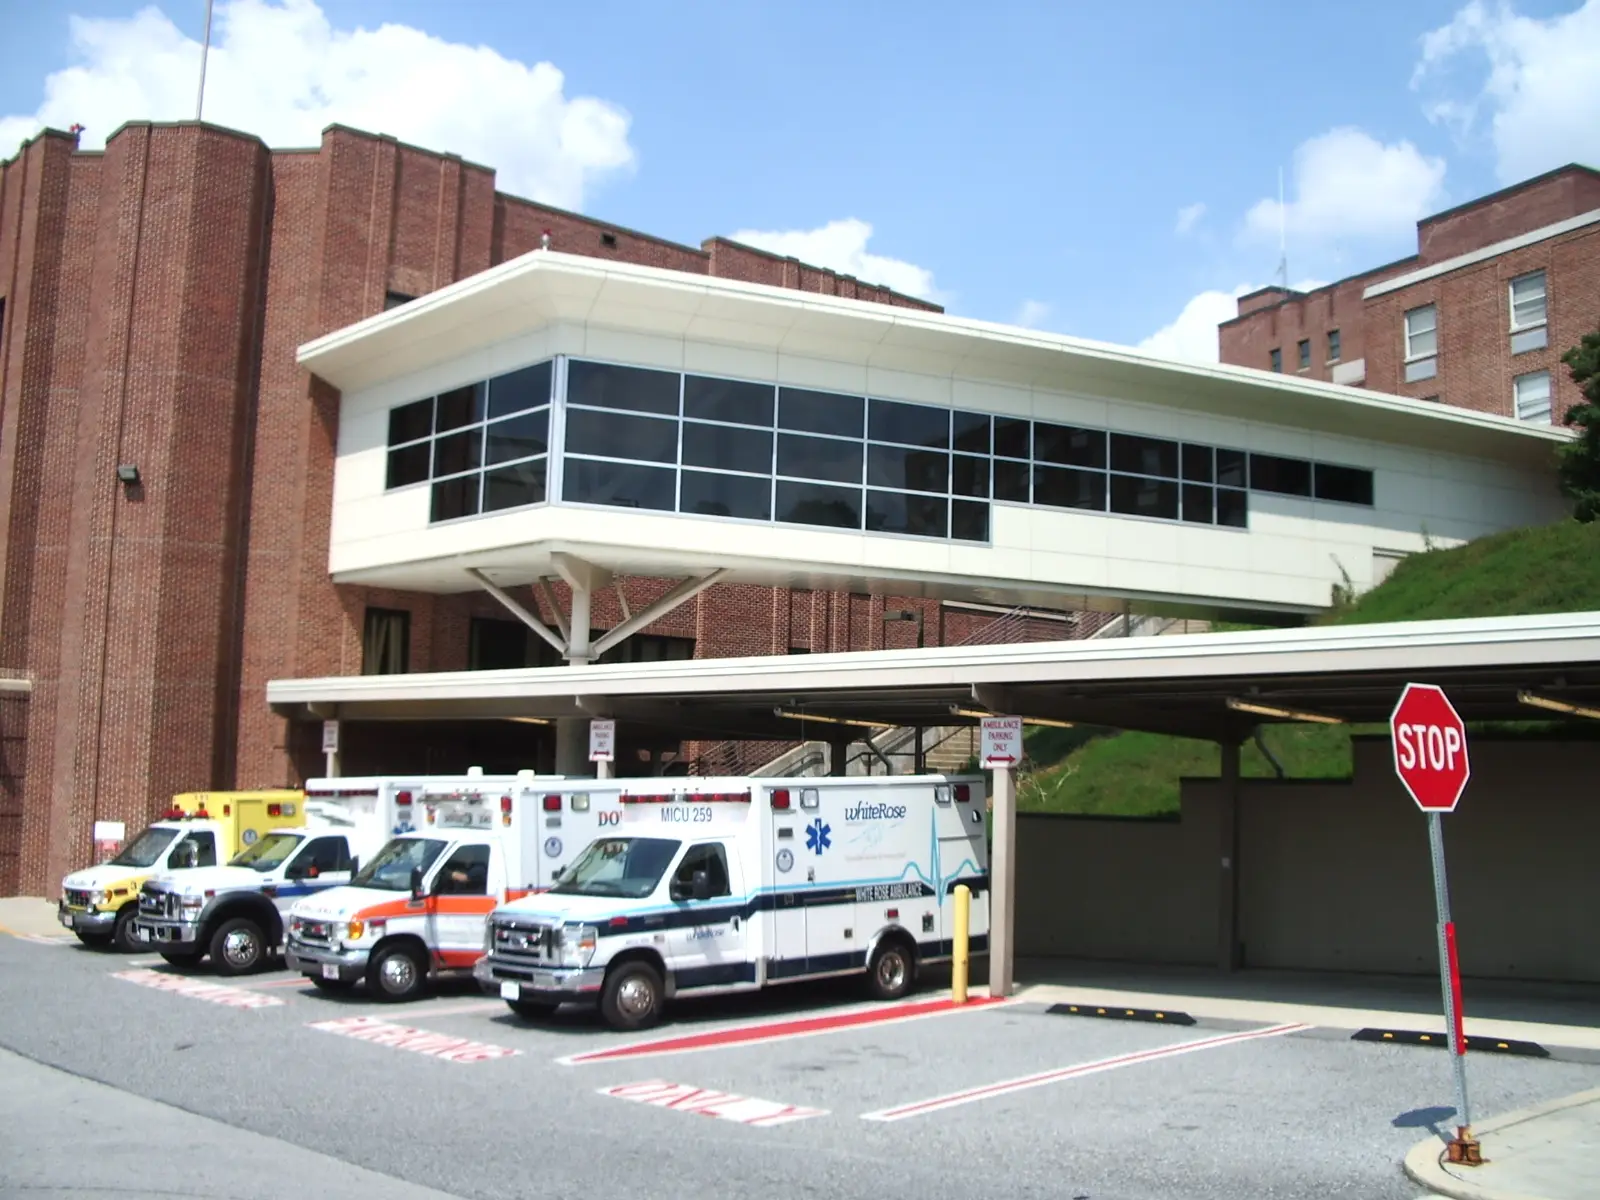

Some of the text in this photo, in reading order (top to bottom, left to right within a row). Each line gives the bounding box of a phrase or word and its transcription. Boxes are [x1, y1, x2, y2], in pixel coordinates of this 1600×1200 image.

[993, 743, 1008, 752] ONLY
[1398, 722, 1461, 771] STOP
[598, 810, 623, 826] DO
[661, 806, 713, 822] MICU 259
[845, 800, 907, 821] whiteRose
[856, 881, 923, 902] WHITE ROSE AMBULANCE
